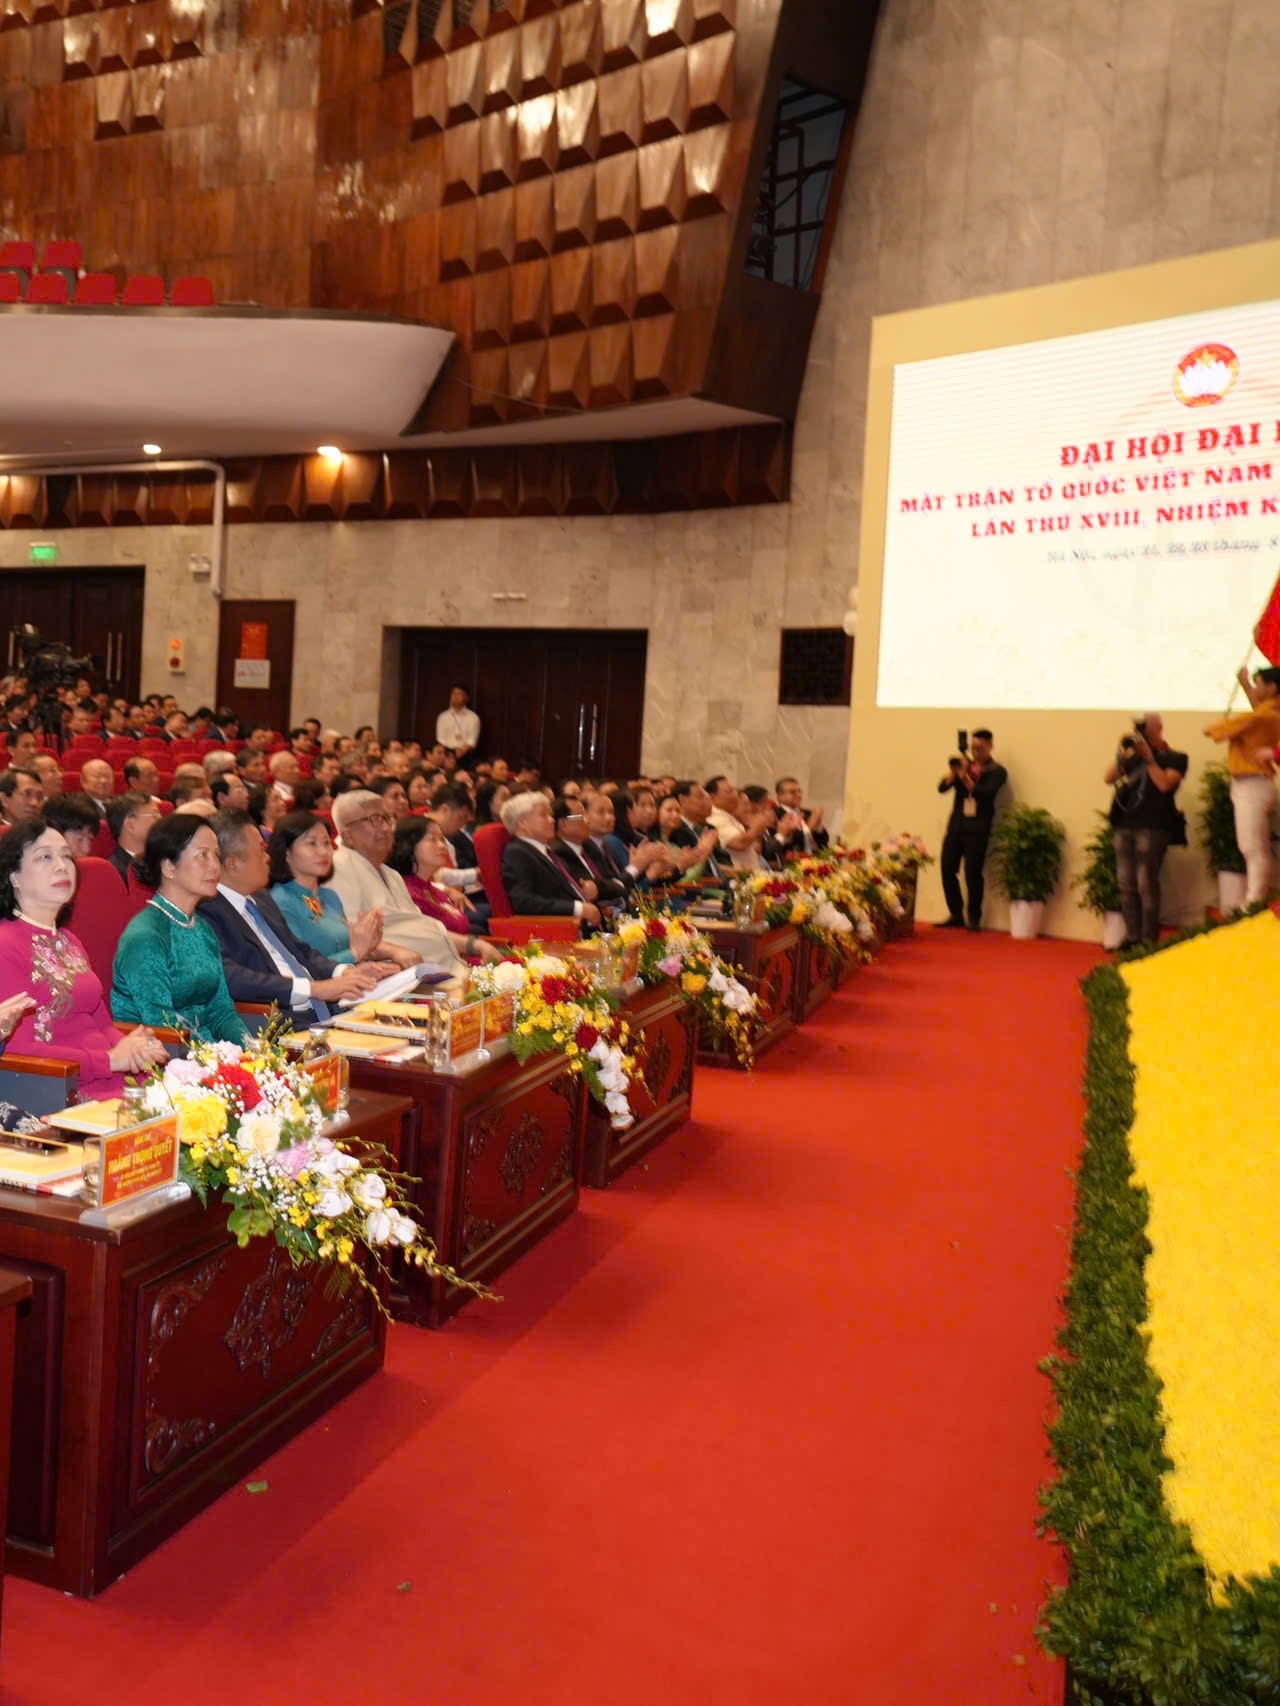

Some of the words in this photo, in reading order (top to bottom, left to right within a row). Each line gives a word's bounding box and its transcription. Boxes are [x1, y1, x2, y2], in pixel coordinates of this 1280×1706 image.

[1060, 440, 1115, 470] ĐẠI
[1126, 427, 1184, 463] HỘI
[1197, 421, 1262, 455] ĐẠI
[1135, 467, 1195, 494] VIỆT
[1204, 462, 1272, 486] NAM
[1156, 498, 1249, 524] NHIỆM
[1261, 497, 1280, 516] K
